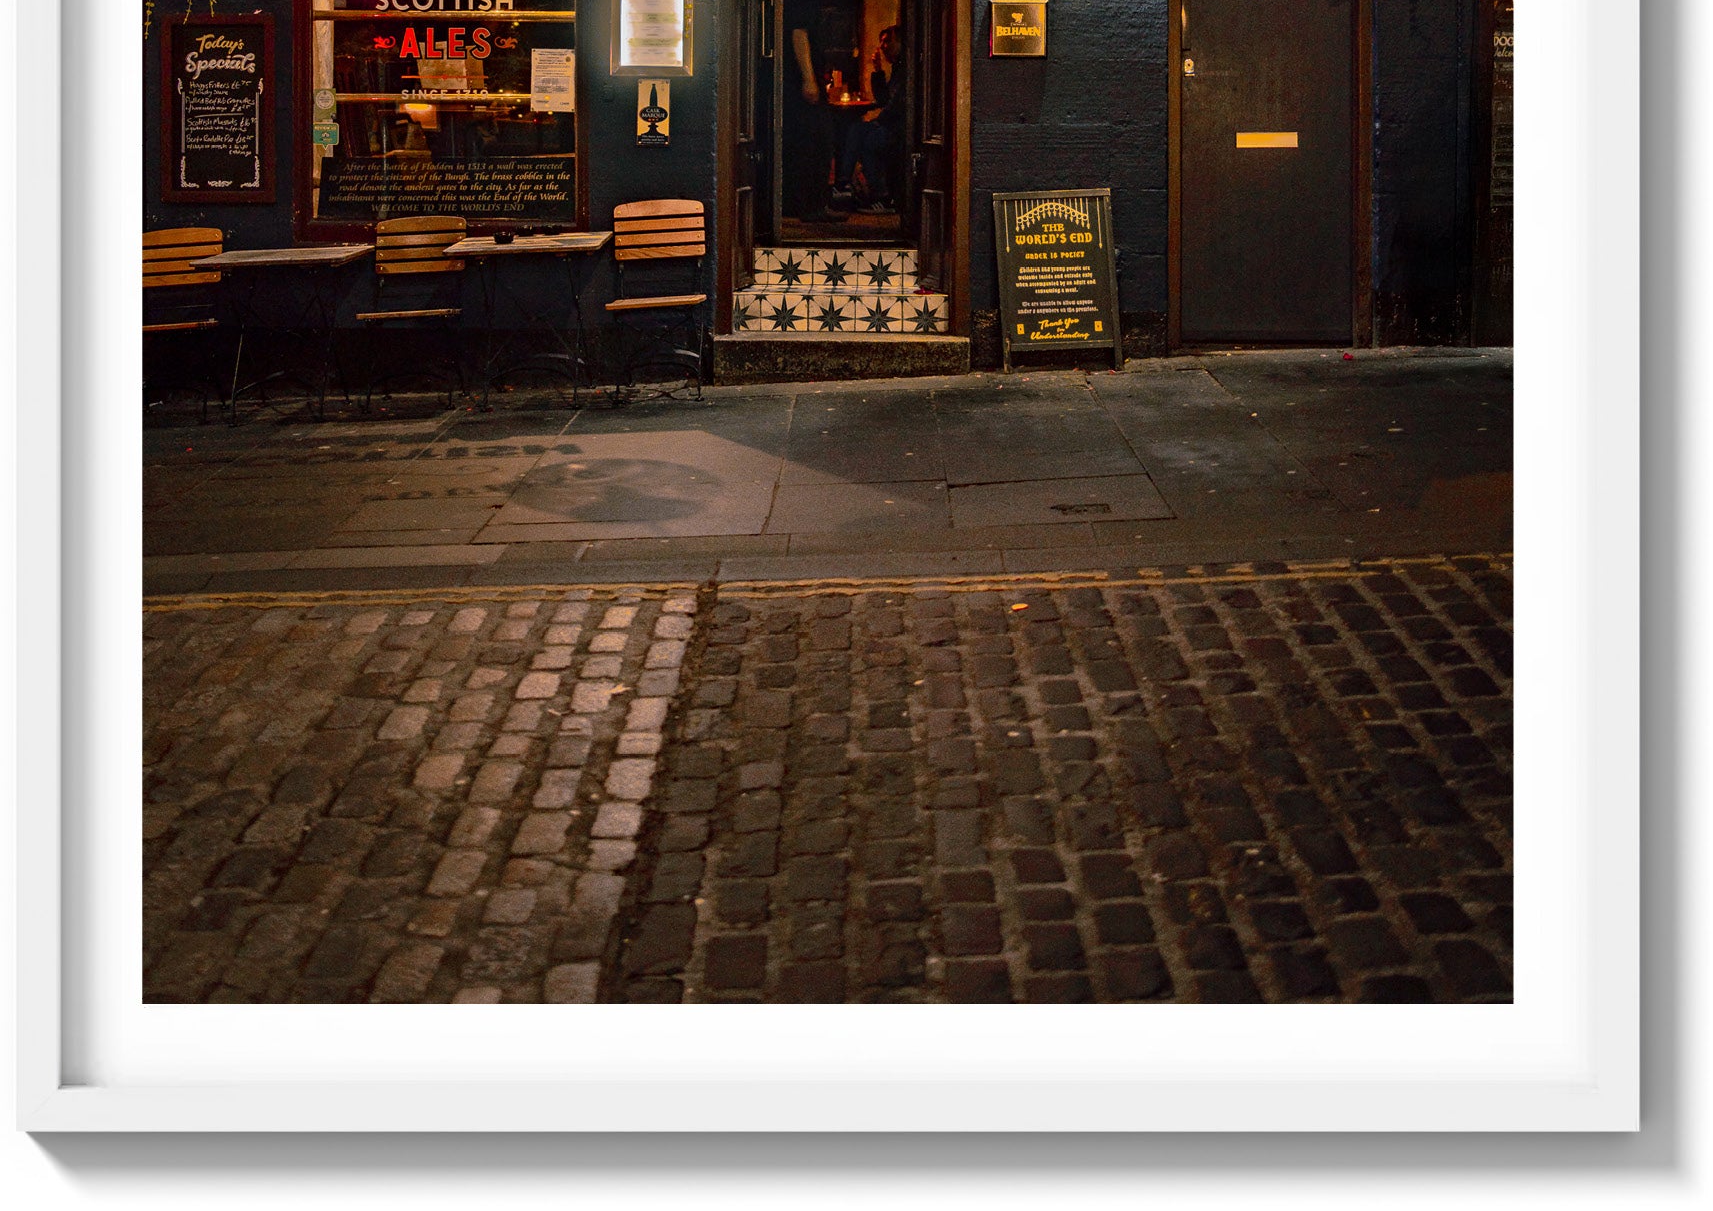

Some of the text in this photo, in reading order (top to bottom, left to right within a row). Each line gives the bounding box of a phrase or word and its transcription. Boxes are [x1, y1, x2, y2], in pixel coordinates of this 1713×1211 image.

[995, 25, 1041, 37] BELHAVEN
[195, 33, 245, 55] Today's
[399, 27, 492, 60] ALES
[185, 51, 256, 80] Specials
[401, 89, 489, 100] SINCE 1719
[345, 162, 365, 173] After
[368, 162, 381, 171] the
[384, 162, 408, 171] Battle
[411, 162, 421, 174] of
[422, 162, 454, 171] Flodden
[456, 162, 465, 171] in
[497, 161, 516, 170] wall
[535, 161, 564, 170] erected
[338, 173, 368, 185] protect
[371, 172, 385, 181] the
[386, 172, 416, 181] citizens
[418, 171, 428, 184] of
[429, 171, 442, 181] the
[474, 172, 489, 181] The
[492, 171, 513, 181] brass
[515, 171, 543, 181] cobbles
[546, 171, 555, 180] in
[557, 171, 571, 180] the
[340, 182, 359, 191] road
[360, 182, 386, 191] denote
[389, 182, 402, 191] the
[404, 183, 434, 191] ancient
[436, 183, 457, 194] gates
[460, 183, 468, 191] to
[470, 181, 484, 191] the
[507, 183, 516, 191] As
[519, 182, 532, 193] far
[545, 181, 559, 190] the
[329, 193, 374, 202] inhabitants
[377, 194, 396, 202] were
[398, 192, 439, 201] concerned
[441, 192, 457, 201] this
[478, 191, 492, 201] the
[494, 191, 510, 201] End
[512, 191, 523, 203] of
[524, 191, 538, 201] the
[540, 191, 569, 201] World.
[460, 203, 501, 211] WORLD'S
[503, 203, 525, 211] END
[1042, 223, 1065, 232] THE
[1015, 232, 1093, 245] WORLD'S END
[1038, 317, 1080, 330] Thank You
[1030, 331, 1091, 340] Understanding
